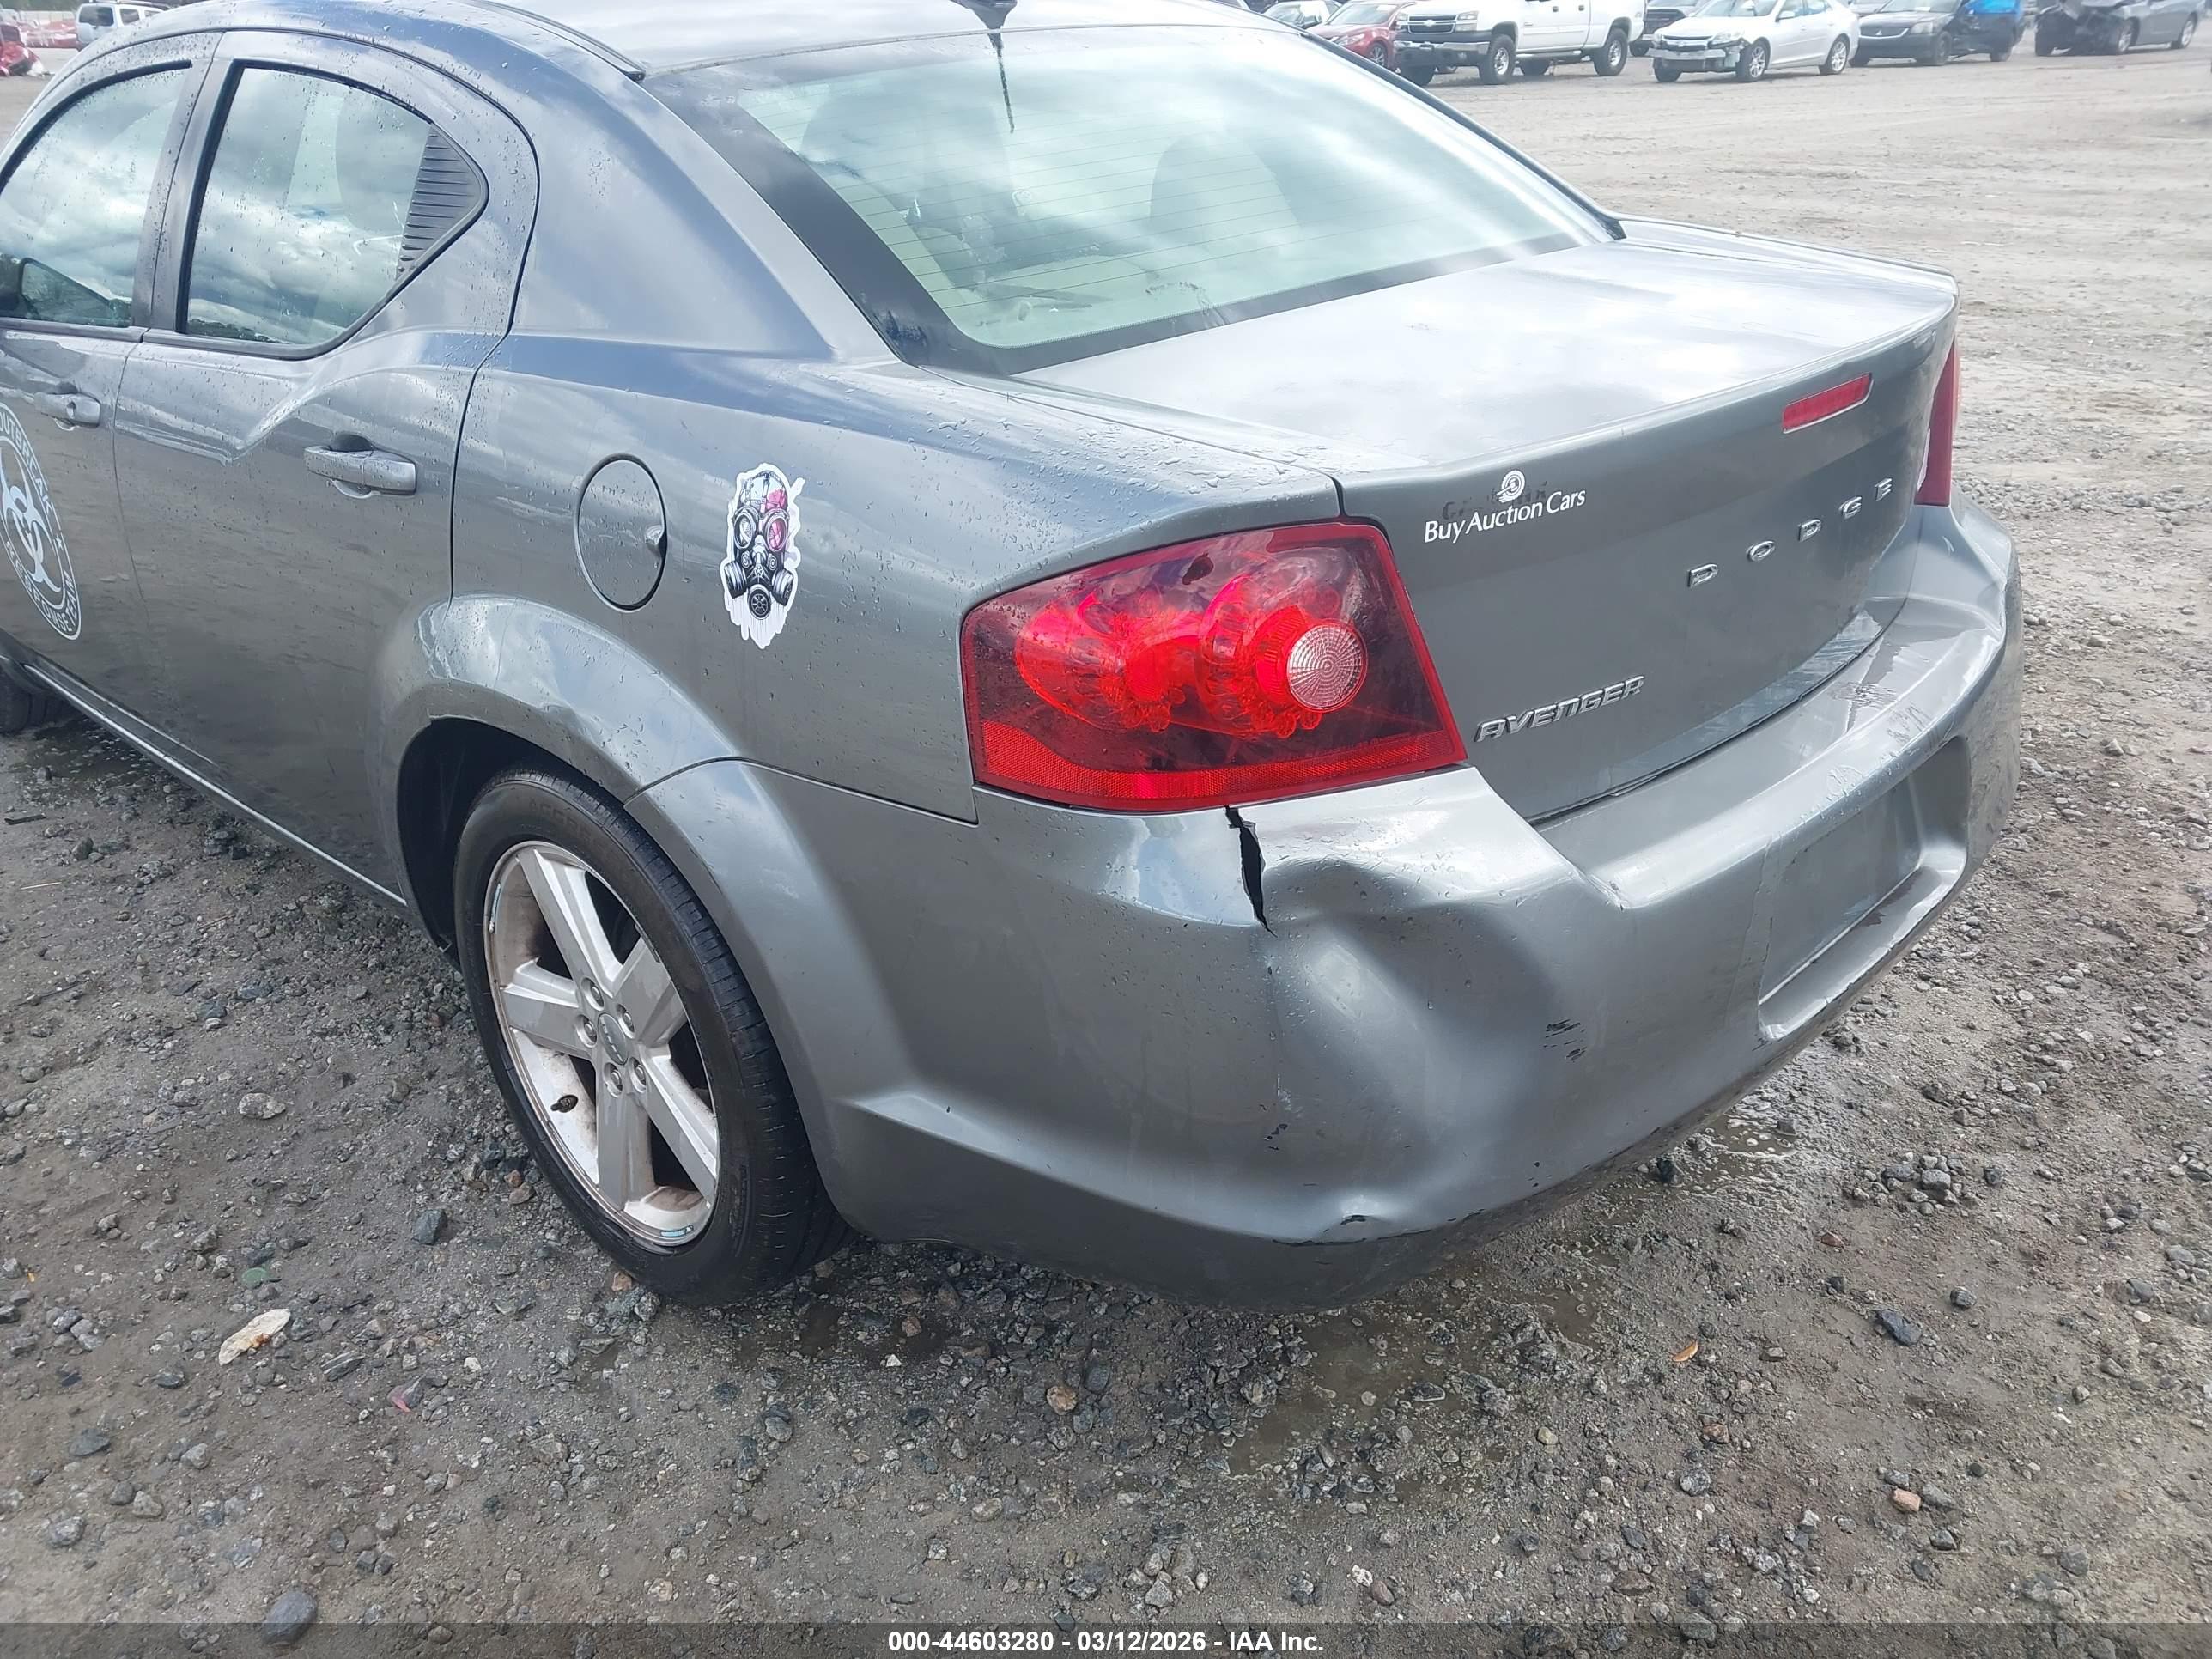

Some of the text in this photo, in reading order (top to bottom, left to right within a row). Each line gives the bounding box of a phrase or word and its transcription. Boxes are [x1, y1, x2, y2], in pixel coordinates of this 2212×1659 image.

[1424, 520, 1466, 544] Buy
[1465, 501, 1544, 534] Auction
[1546, 489, 1586, 514] Cars
[1686, 477, 1893, 588] DODGE
[64, 569, 78, 626] TEAM
[1474, 675, 1645, 743] AVENGER
